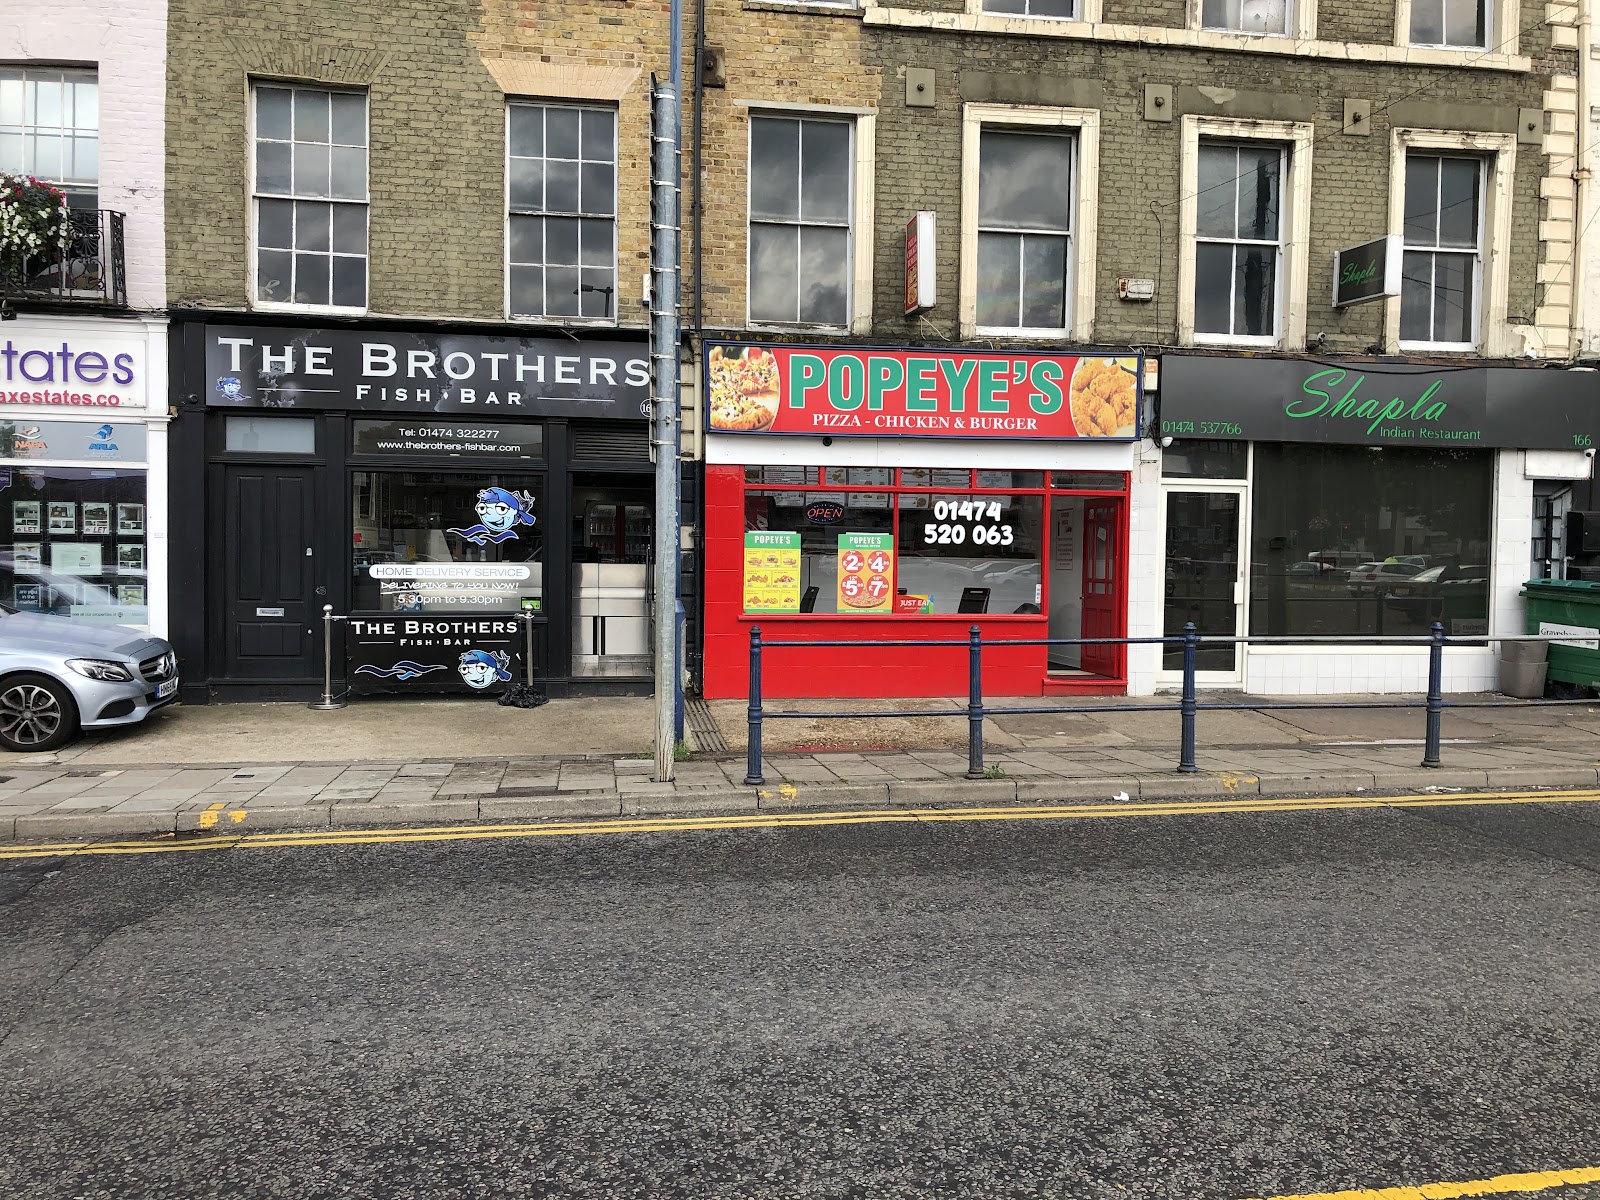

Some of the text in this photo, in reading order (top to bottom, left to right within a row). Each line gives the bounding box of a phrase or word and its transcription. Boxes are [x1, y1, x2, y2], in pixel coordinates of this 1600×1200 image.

[1340, 259, 1376, 286] Shapla
[0, 340, 134, 385] tates
[217, 336, 649, 387] THE BROTHERS
[789, 353, 1064, 415] POPEYE'S
[0, 389, 120, 406] axestates.co
[356, 384, 522, 405] FISH BAR
[1285, 367, 1449, 436] Shapla
[812, 413, 862, 427] PIZZA
[874, 415, 950, 429] CHICKEN
[953, 417, 966, 429] &
[969, 417, 1038, 430] BURGER
[1162, 420, 1242, 435] 01474 537766
[399, 428, 500, 439] Tel: 01474 322277
[1379, 426, 1481, 440] Indian Restaurant
[1572, 434, 1592, 447] 166
[377, 441, 521, 452] www.thebrothers-fishbar.com
[806, 507, 844, 518] OPEN
[934, 501, 1002, 521] 01474
[754, 535, 791, 544] POPEYE'S
[849, 536, 882, 545] POPEYE'S
[924, 524, 1014, 545] 520 063
[376, 567, 523, 577] HOME DELIVERY SERVICE
[398, 594, 503, 606] 5.30pm to 9.30pm
[351, 620, 518, 635] THE BROTHERS
[400, 638, 471, 646] FISH BAR
